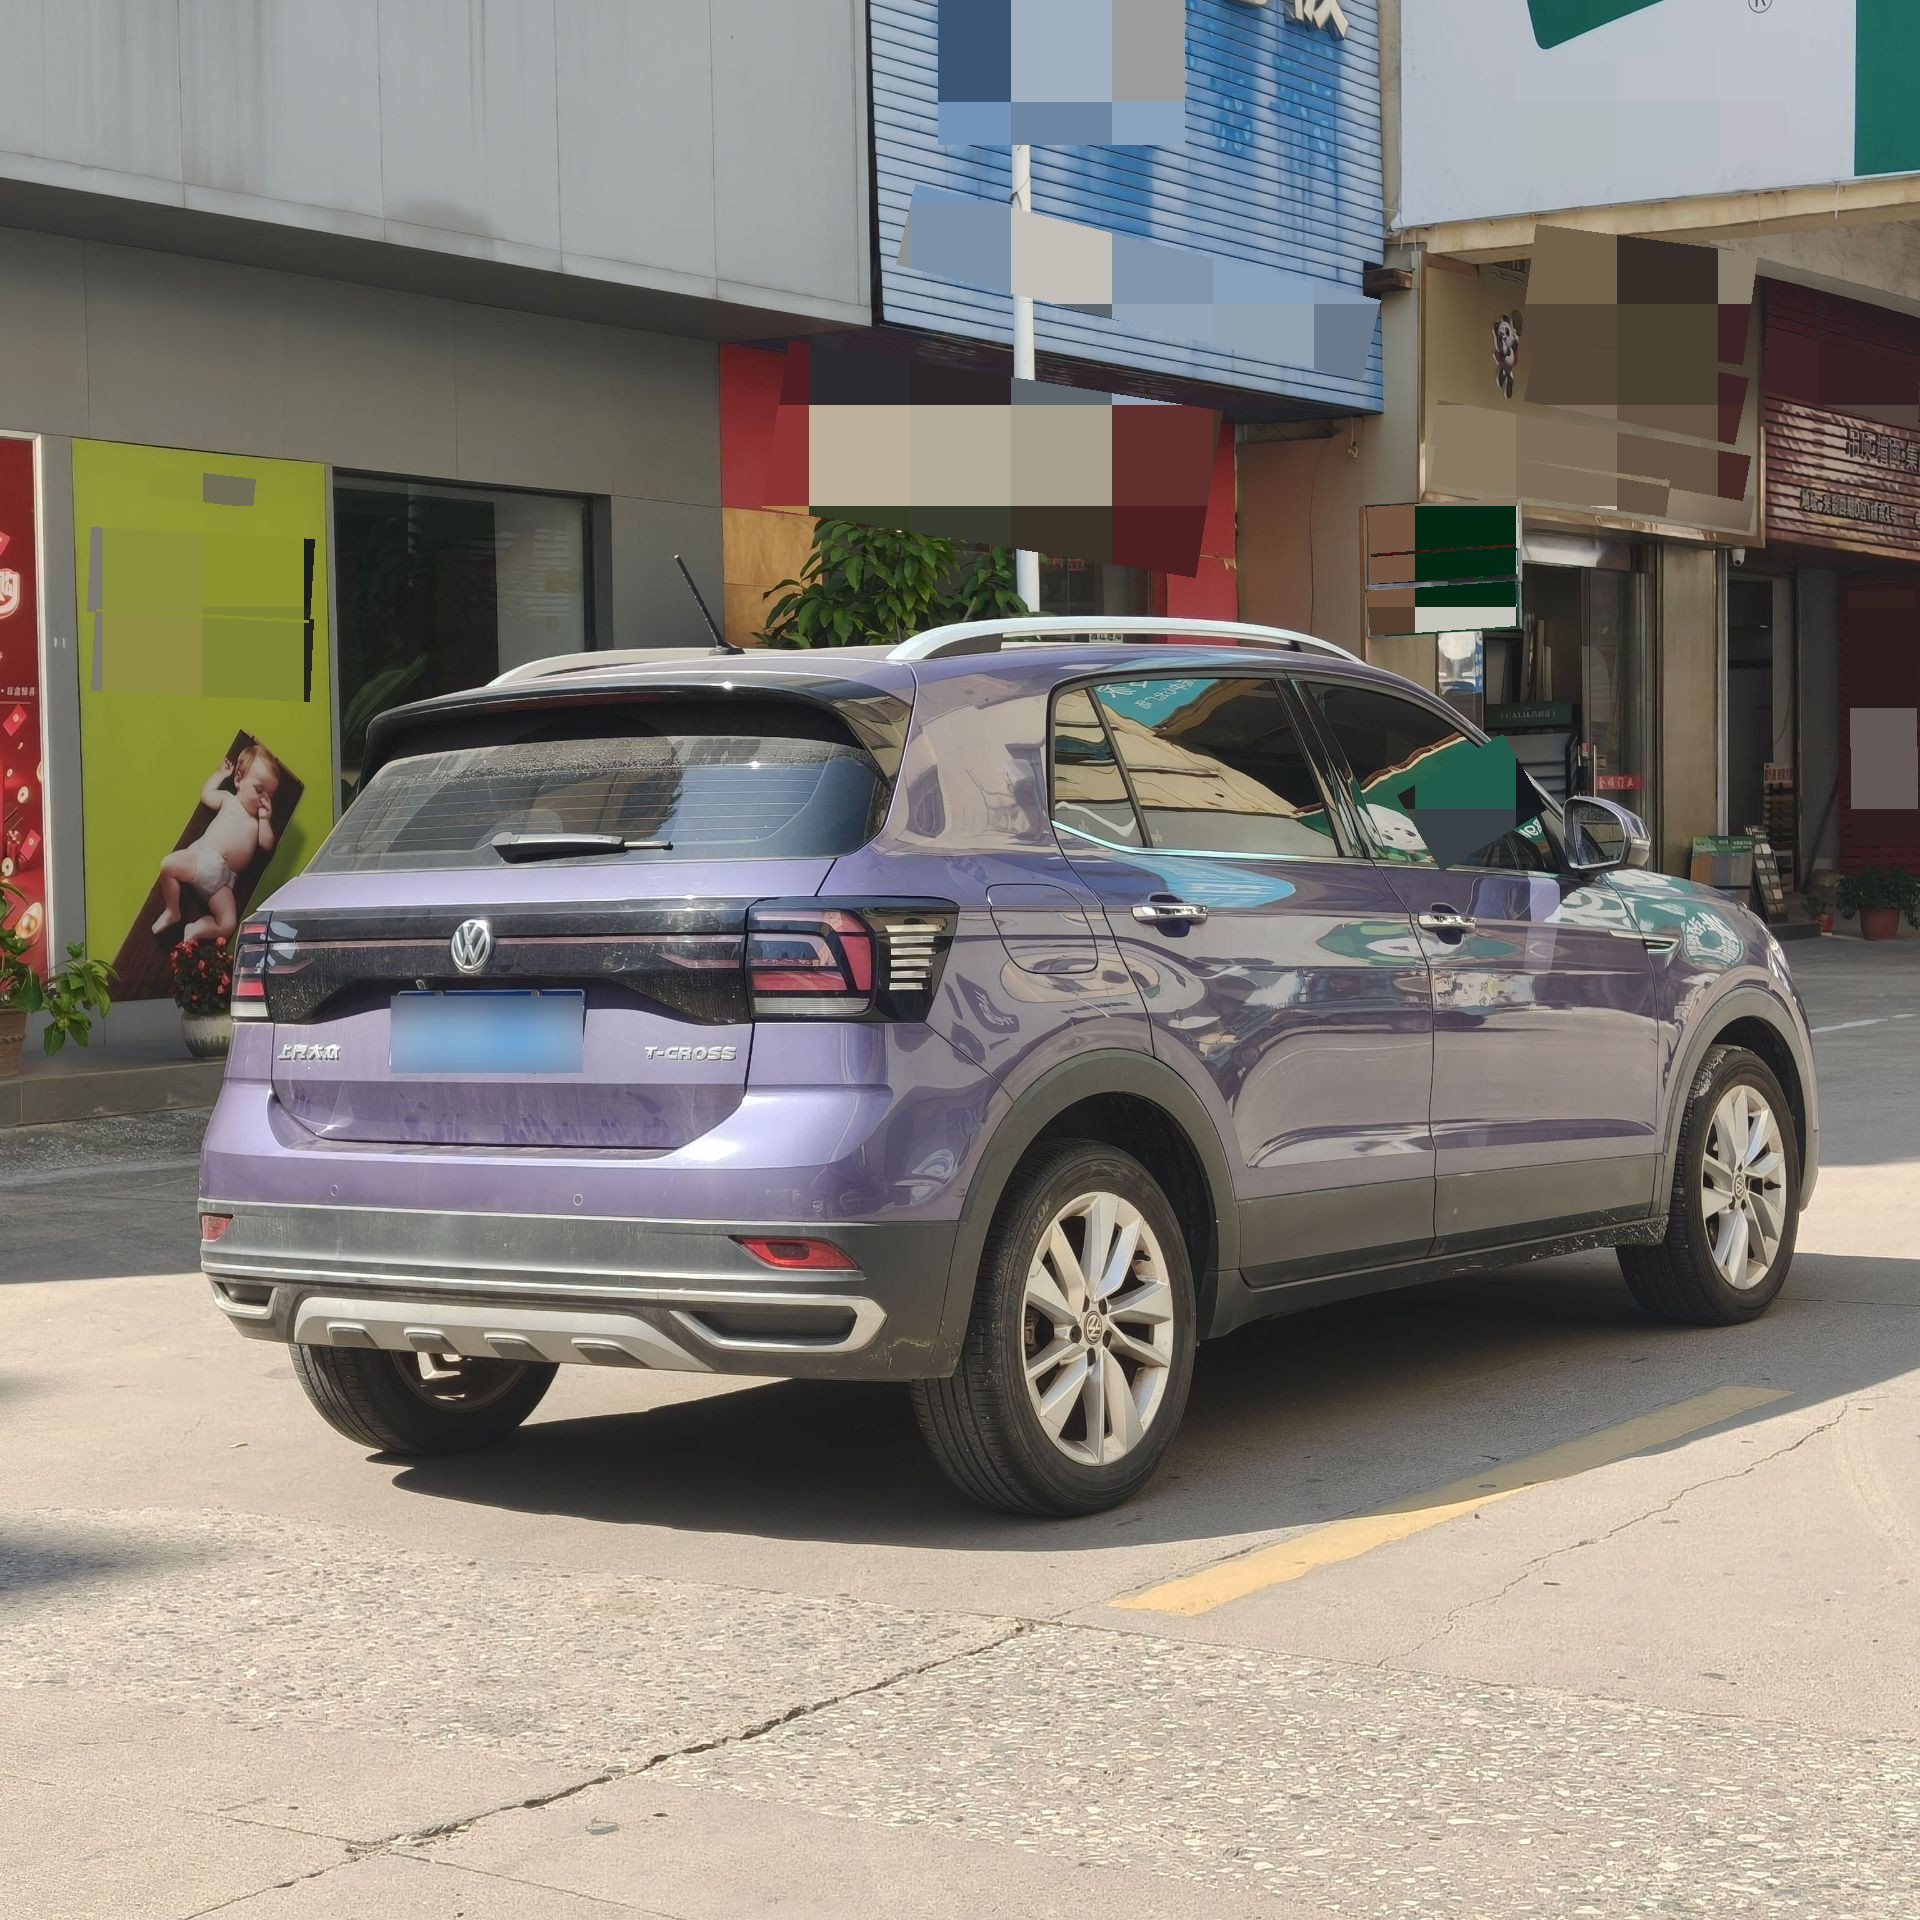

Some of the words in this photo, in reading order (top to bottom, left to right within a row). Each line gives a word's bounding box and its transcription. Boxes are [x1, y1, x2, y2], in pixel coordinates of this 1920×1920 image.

[277, 1043, 342, 1061] 上汽大众
[644, 1045, 737, 1061] T-CROSS
